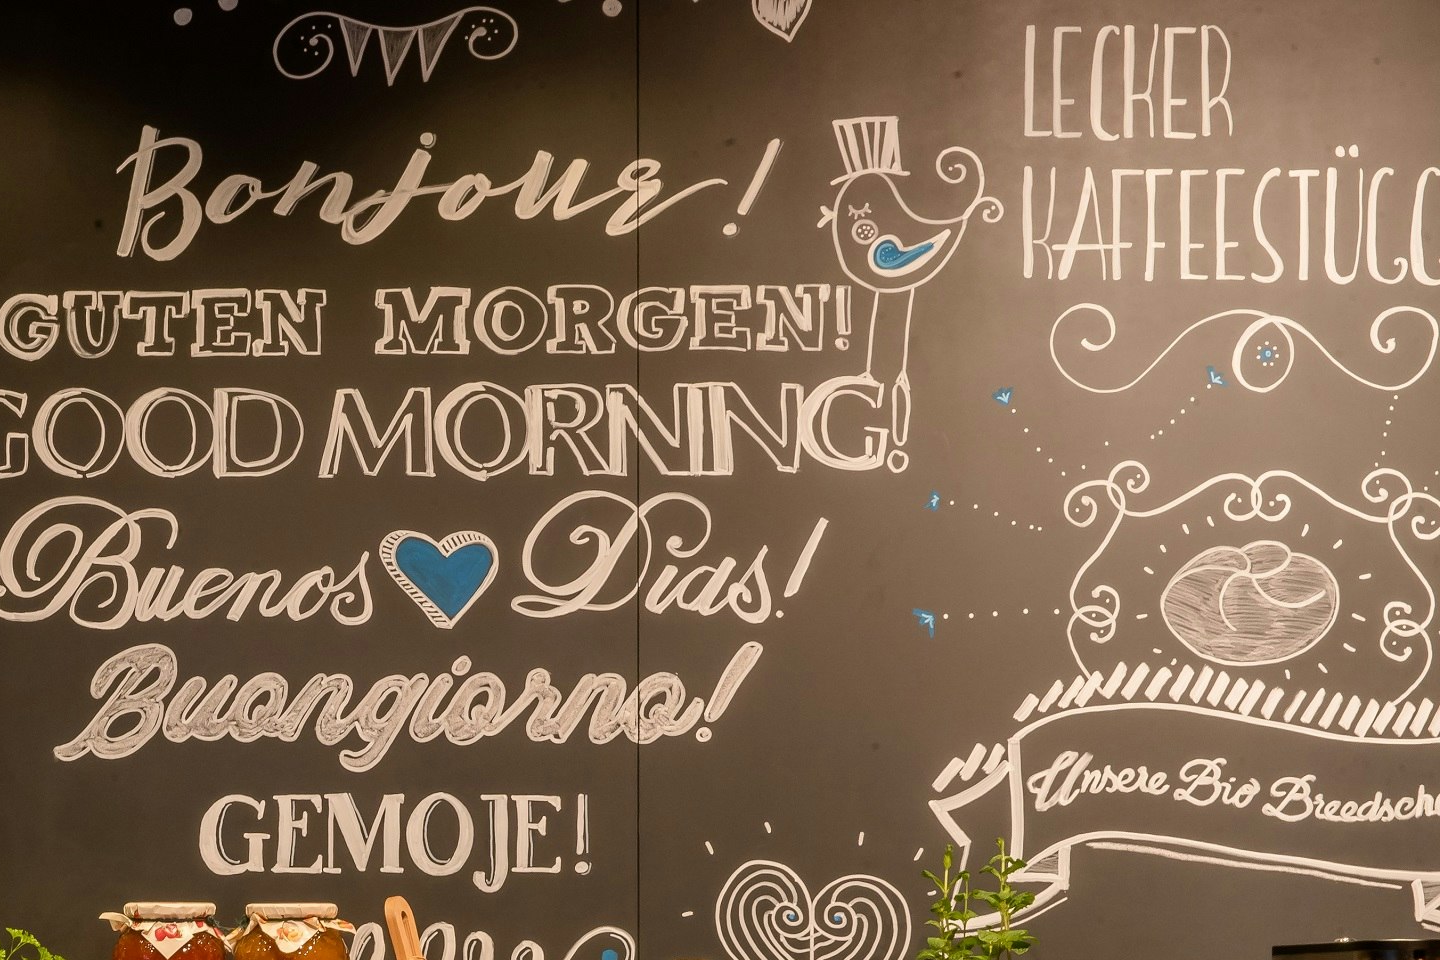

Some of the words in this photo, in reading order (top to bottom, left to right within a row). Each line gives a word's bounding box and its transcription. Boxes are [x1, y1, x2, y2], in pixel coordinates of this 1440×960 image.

[1023, 23, 1234, 141] LECKER
[373, 283, 854, 356] MORGEN!
[317, 373, 913, 481] MORNING!
[51, 641, 764, 773] Buongiorno!
[1026, 749, 1171, 812] Unsere
[1173, 756, 1261, 810] Bio
[197, 791, 593, 893] GEMOJE!
